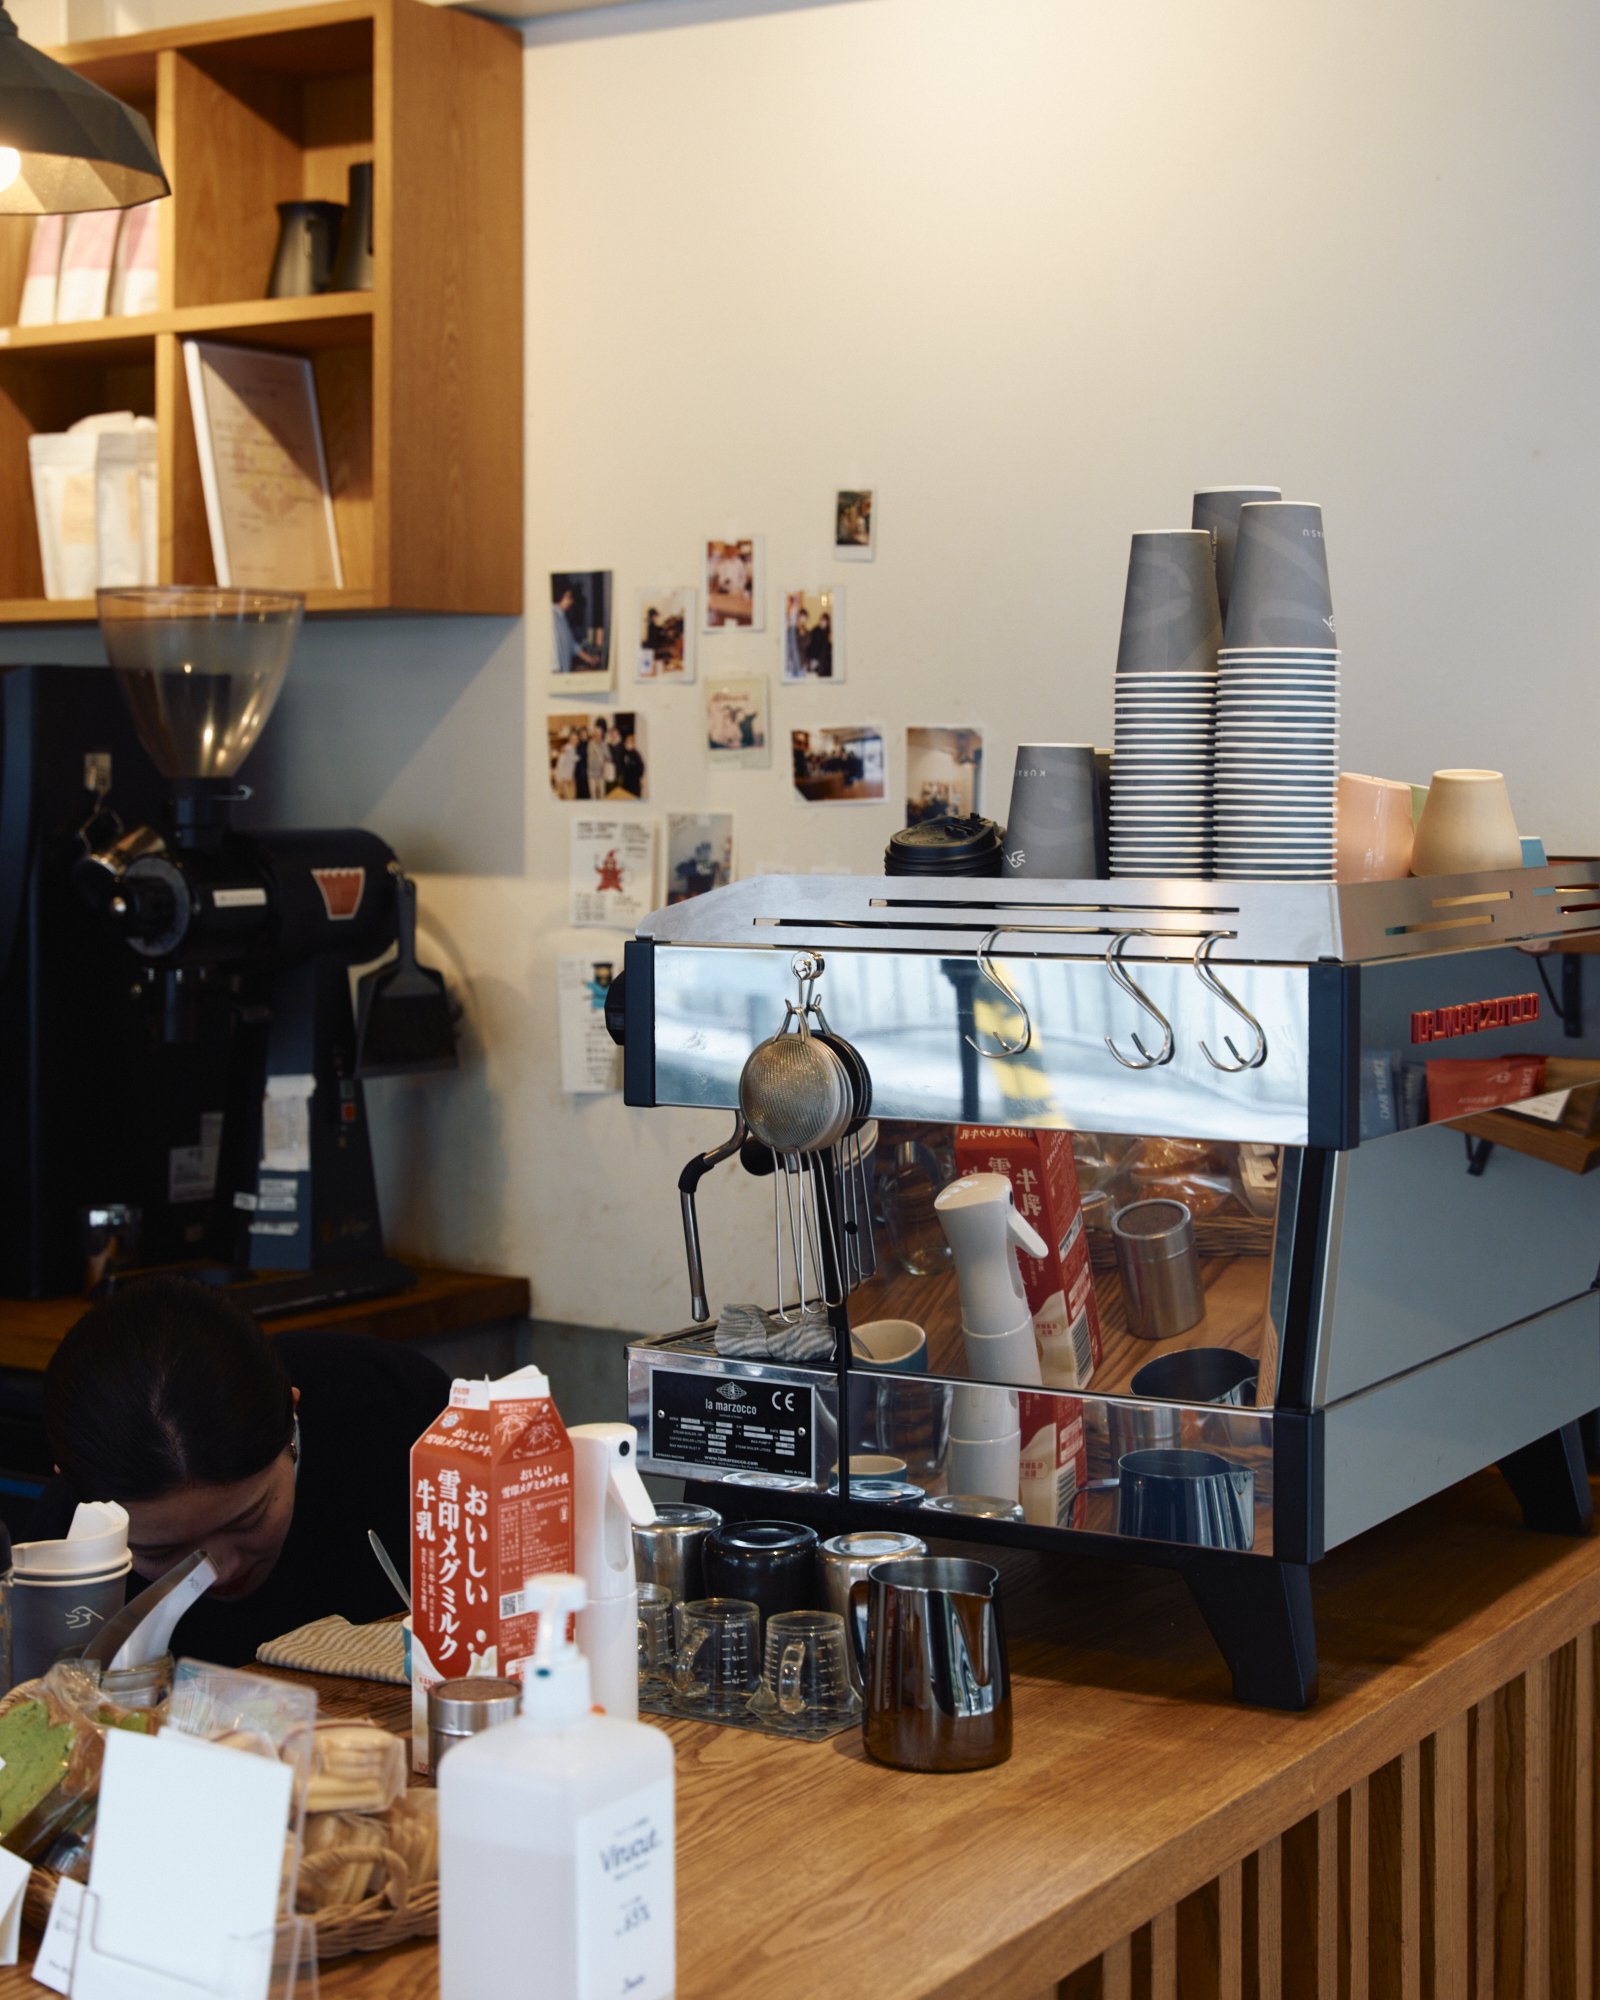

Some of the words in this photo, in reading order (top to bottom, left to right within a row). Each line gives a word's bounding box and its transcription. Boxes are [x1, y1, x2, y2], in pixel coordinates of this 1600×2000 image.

[705, 1397, 713, 1410] la
[715, 1401, 757, 1415] marzocco
[771, 1390, 794, 1413] CE
[519, 1464, 553, 1481] おいしい
[704, 1455, 759, 1467] www.lamarzocco.com
[415, 1478, 437, 1542] 牛乳
[464, 1484, 489, 1606] おいしい
[437, 1468, 462, 1661] 雪印メグミルク
